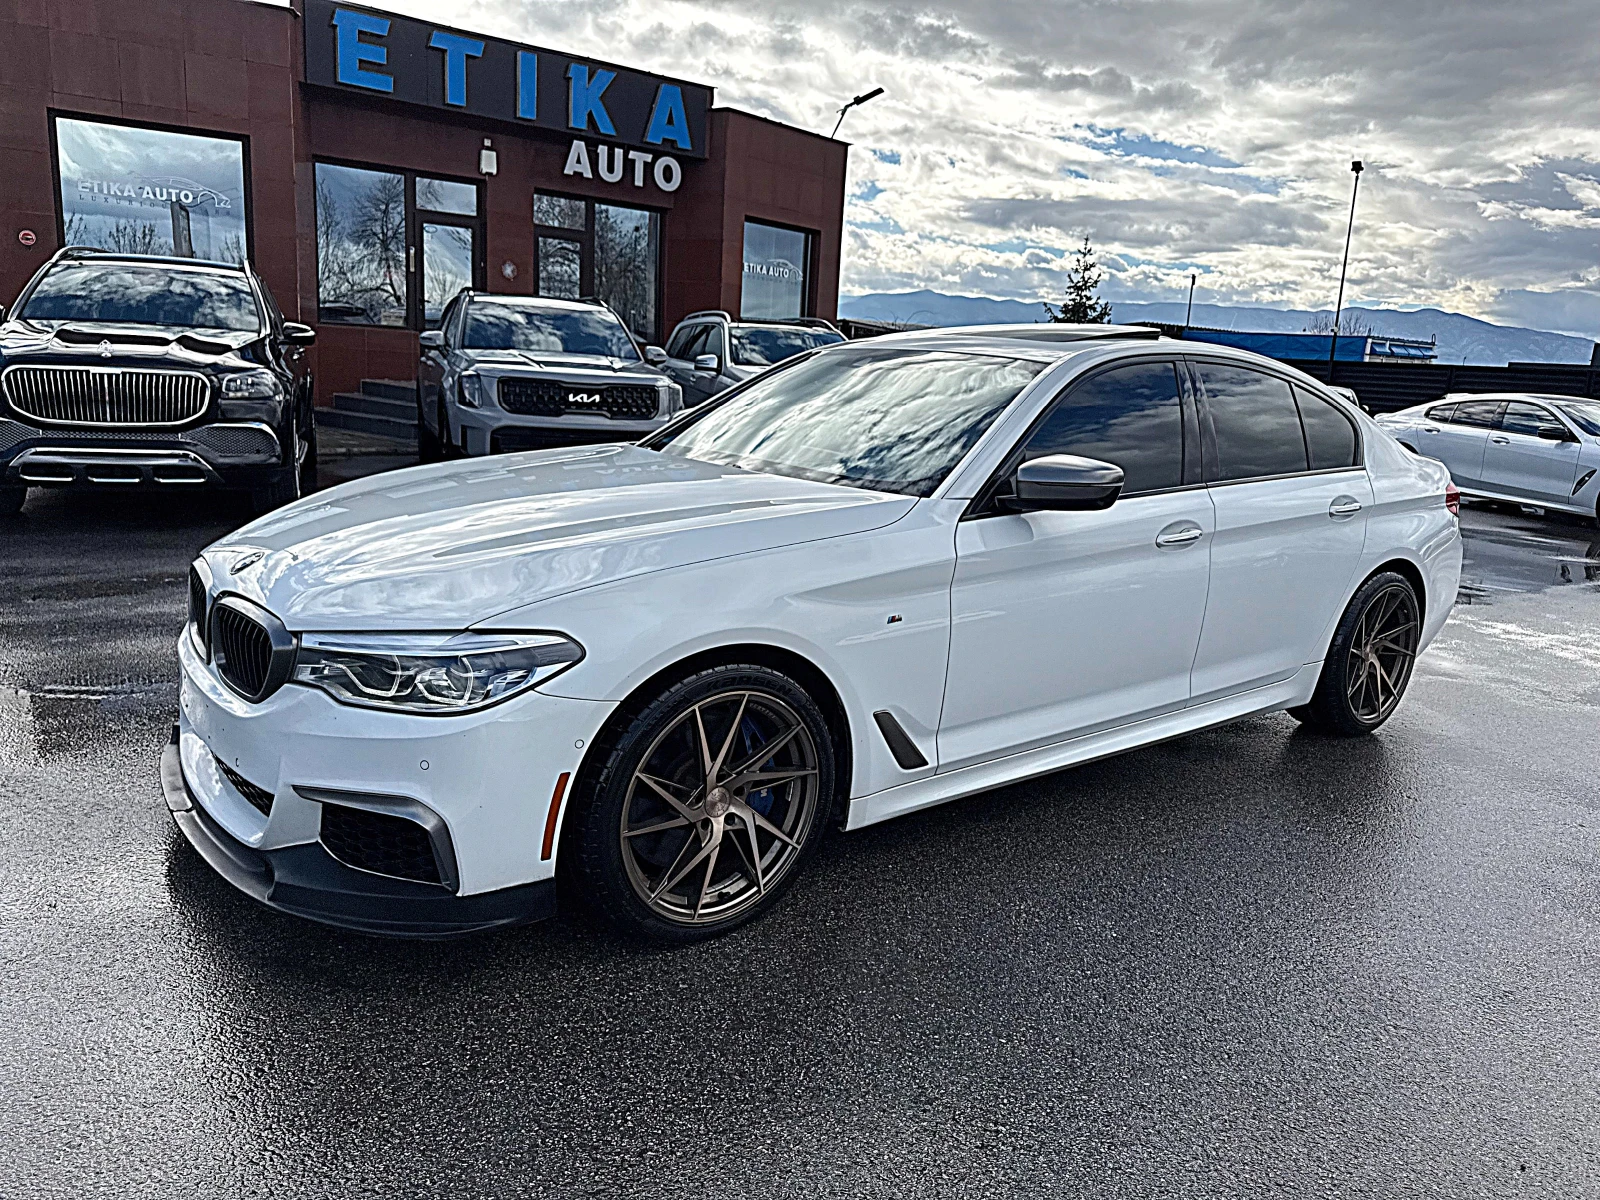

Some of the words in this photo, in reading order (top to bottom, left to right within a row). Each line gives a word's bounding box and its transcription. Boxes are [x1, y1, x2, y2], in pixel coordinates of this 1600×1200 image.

[332, 8, 693, 150] ETIKA
[563, 139, 683, 192] AUTO
[77, 179, 137, 198] ETIKA
[142, 185, 194, 204] AUTO
[744, 262, 767, 275] ETIKA
[769, 266, 789, 278] AUTO
[568, 393, 600, 403] KIA
